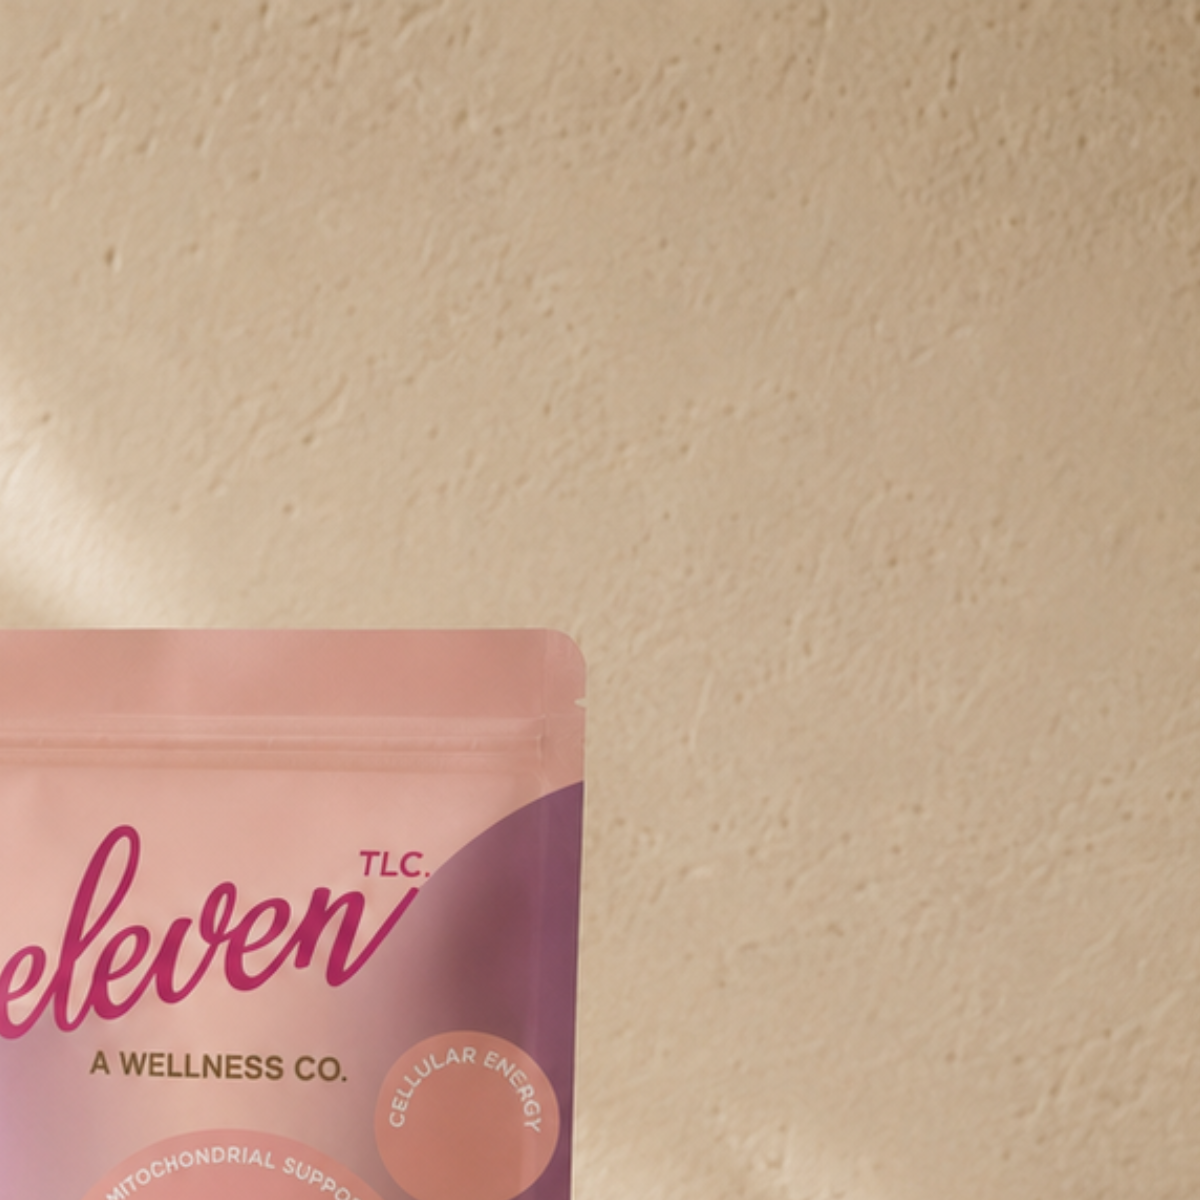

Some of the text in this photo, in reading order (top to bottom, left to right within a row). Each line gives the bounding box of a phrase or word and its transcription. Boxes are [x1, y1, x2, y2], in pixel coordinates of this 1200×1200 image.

[89, 1050, 348, 1082] A WELLNESS CO.
[389, 1047, 543, 1133] CELLULAR ENERGY
